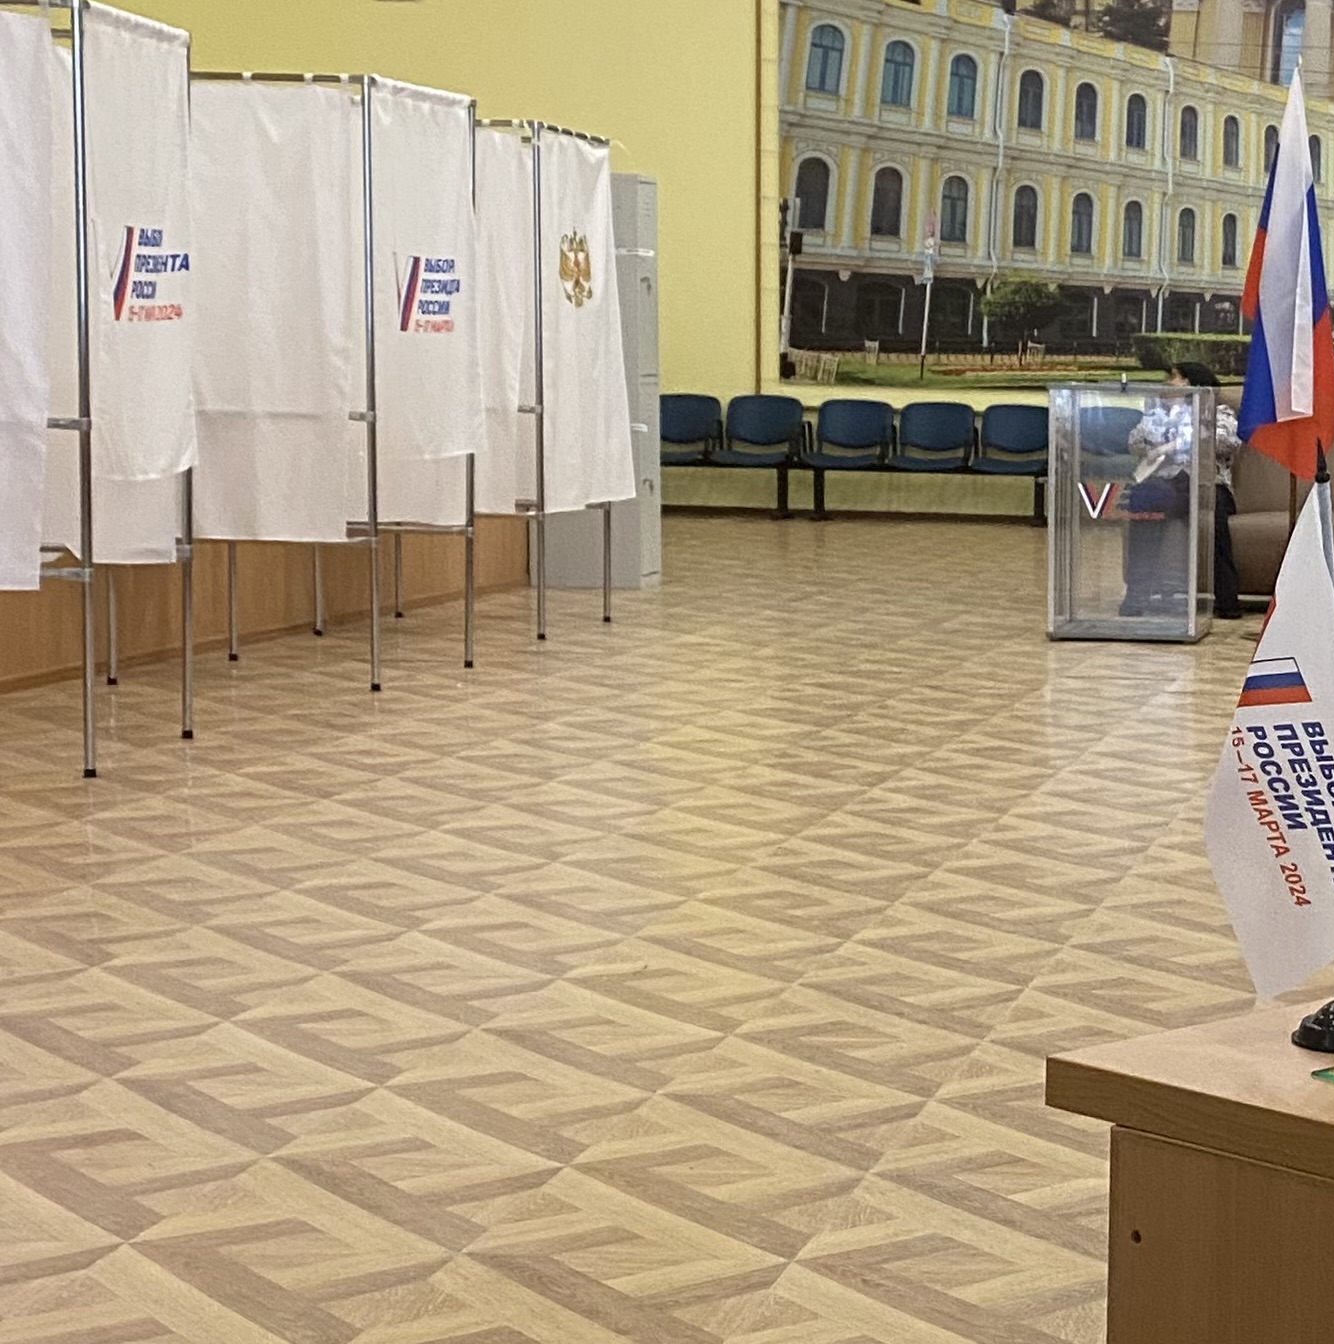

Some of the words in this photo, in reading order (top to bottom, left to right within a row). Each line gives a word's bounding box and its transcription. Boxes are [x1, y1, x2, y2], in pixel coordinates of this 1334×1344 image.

[1245, 725, 1308, 830] РОССИИ
[1246, 790, 1290, 858] МАРТА
[1279, 862, 1312, 907] 2024
